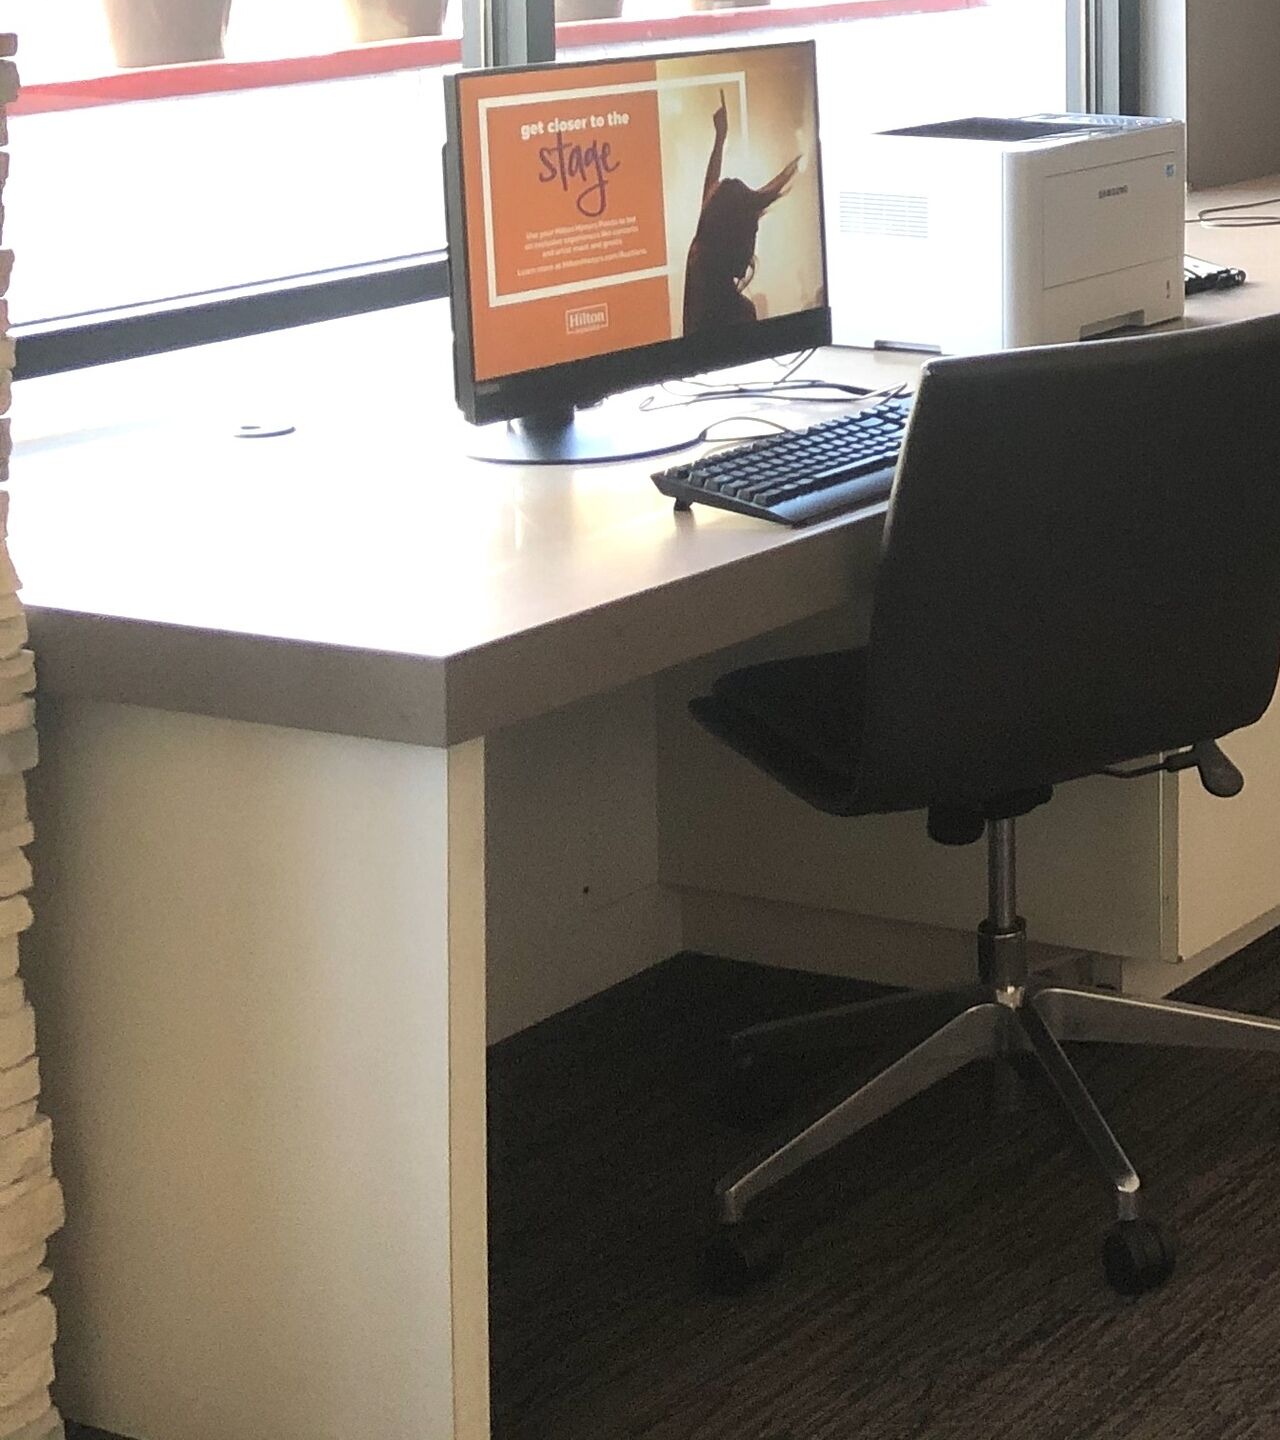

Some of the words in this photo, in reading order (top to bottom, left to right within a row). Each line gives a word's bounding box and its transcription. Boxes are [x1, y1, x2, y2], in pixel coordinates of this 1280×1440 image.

[520, 121, 544, 141] get
[547, 117, 587, 134] closer
[590, 114, 605, 128] to
[607, 110, 630, 127] the
[538, 130, 621, 217] stage
[569, 311, 605, 329] Hilton
